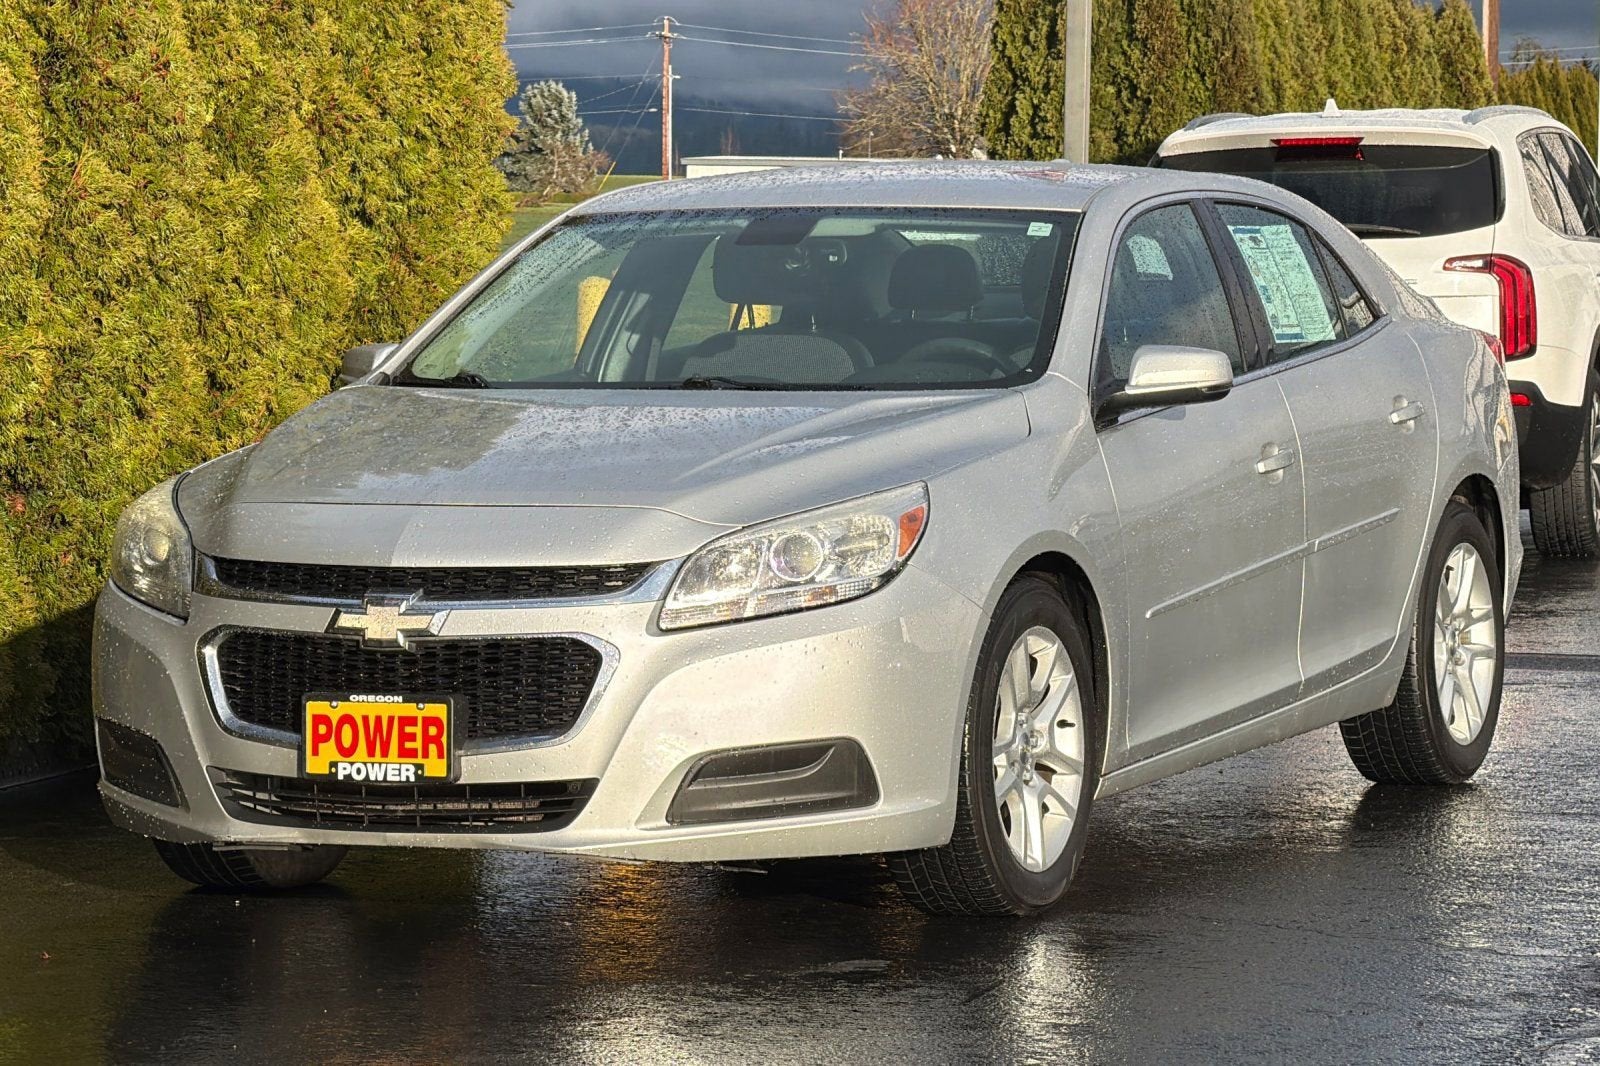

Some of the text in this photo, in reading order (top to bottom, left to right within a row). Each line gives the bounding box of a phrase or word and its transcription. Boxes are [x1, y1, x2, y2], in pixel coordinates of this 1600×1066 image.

[349, 694, 403, 703] OREGON
[311, 713, 445, 759] POWER
[337, 762, 416, 781] POWER
